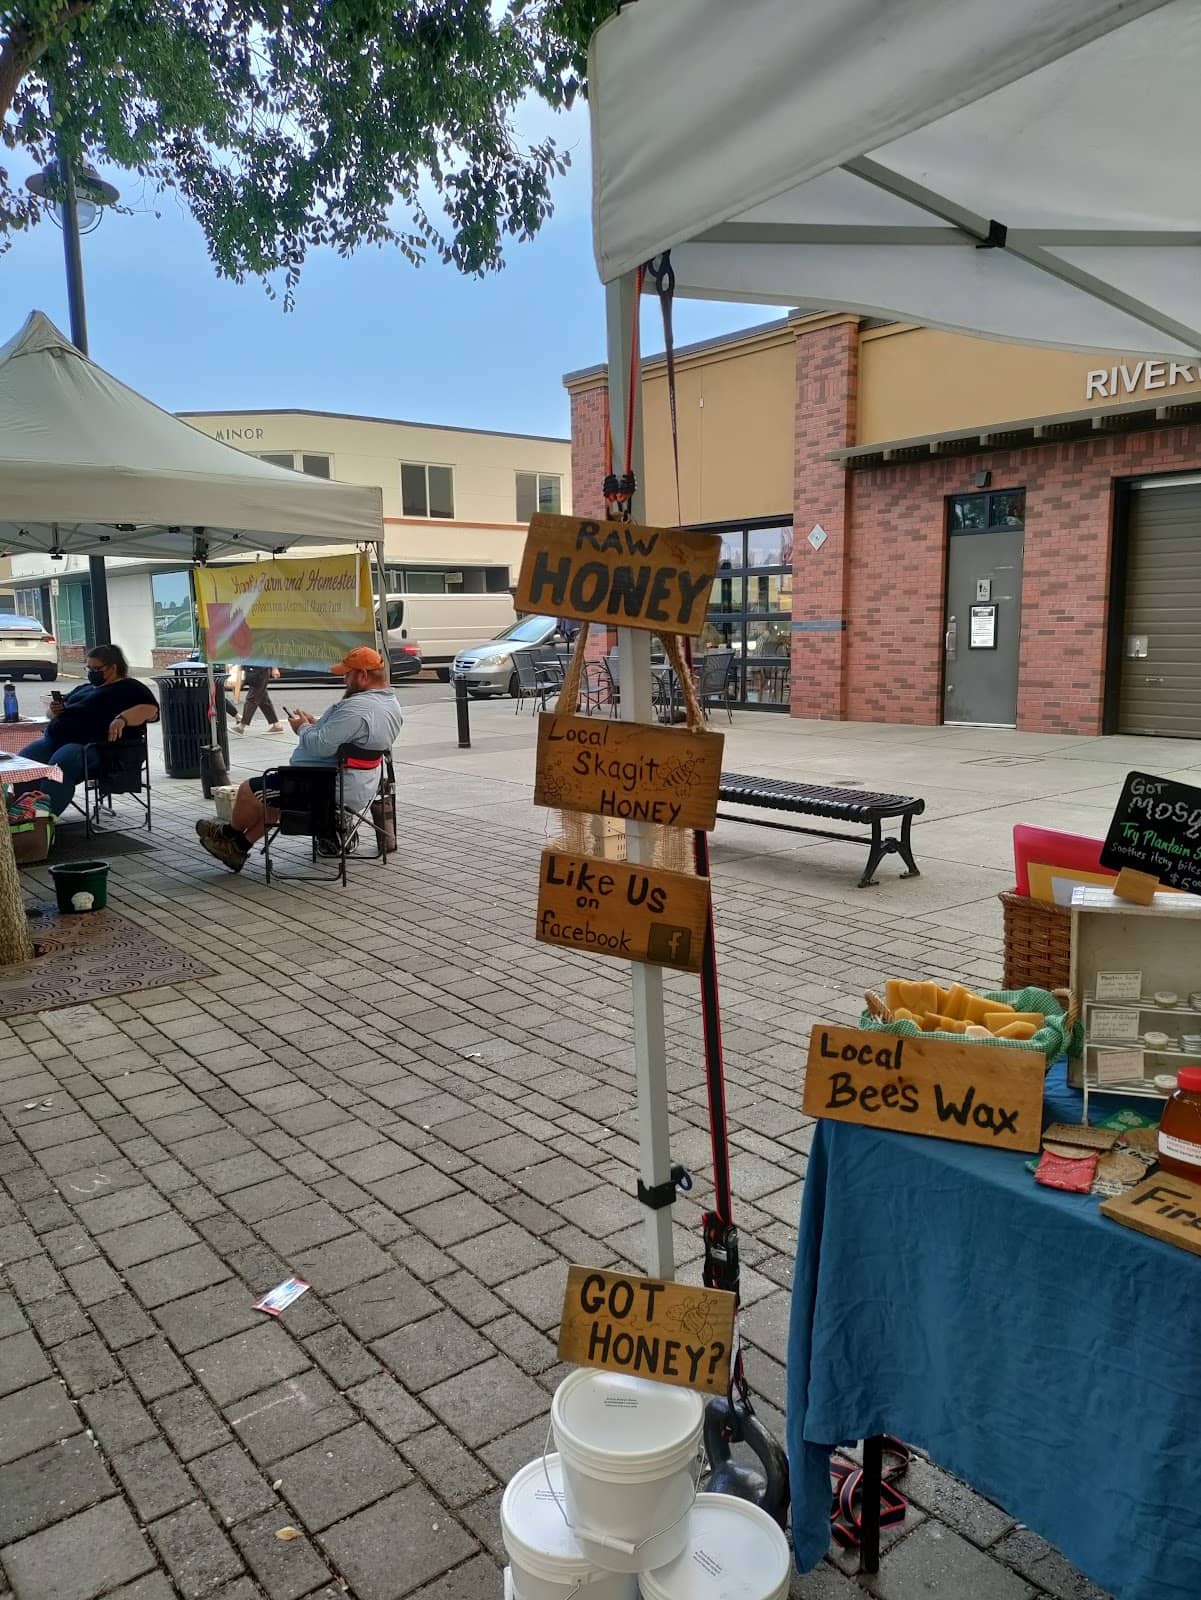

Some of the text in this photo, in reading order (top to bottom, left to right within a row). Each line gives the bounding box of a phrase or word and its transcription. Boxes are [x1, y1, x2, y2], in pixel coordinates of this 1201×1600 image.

[215, 428, 264, 441] MINOR
[576, 521, 659, 556] RAW
[284, 570, 305, 593] and
[529, 552, 713, 624] HONEY
[548, 720, 609, 745] Local
[572, 751, 660, 791] Skagit
[600, 790, 681, 824] HONEY
[1120, 822, 1139, 846] Try
[1143, 830, 1190, 857] Plantain
[547, 856, 667, 913] Like Us
[576, 896, 599, 909] on
[540, 910, 632, 951] facebook
[821, 1033, 903, 1069] Local
[825, 1072, 1019, 1136] Bee's Wax
[580, 1274, 665, 1322] GOT
[588, 1321, 725, 1385] HONEY?
